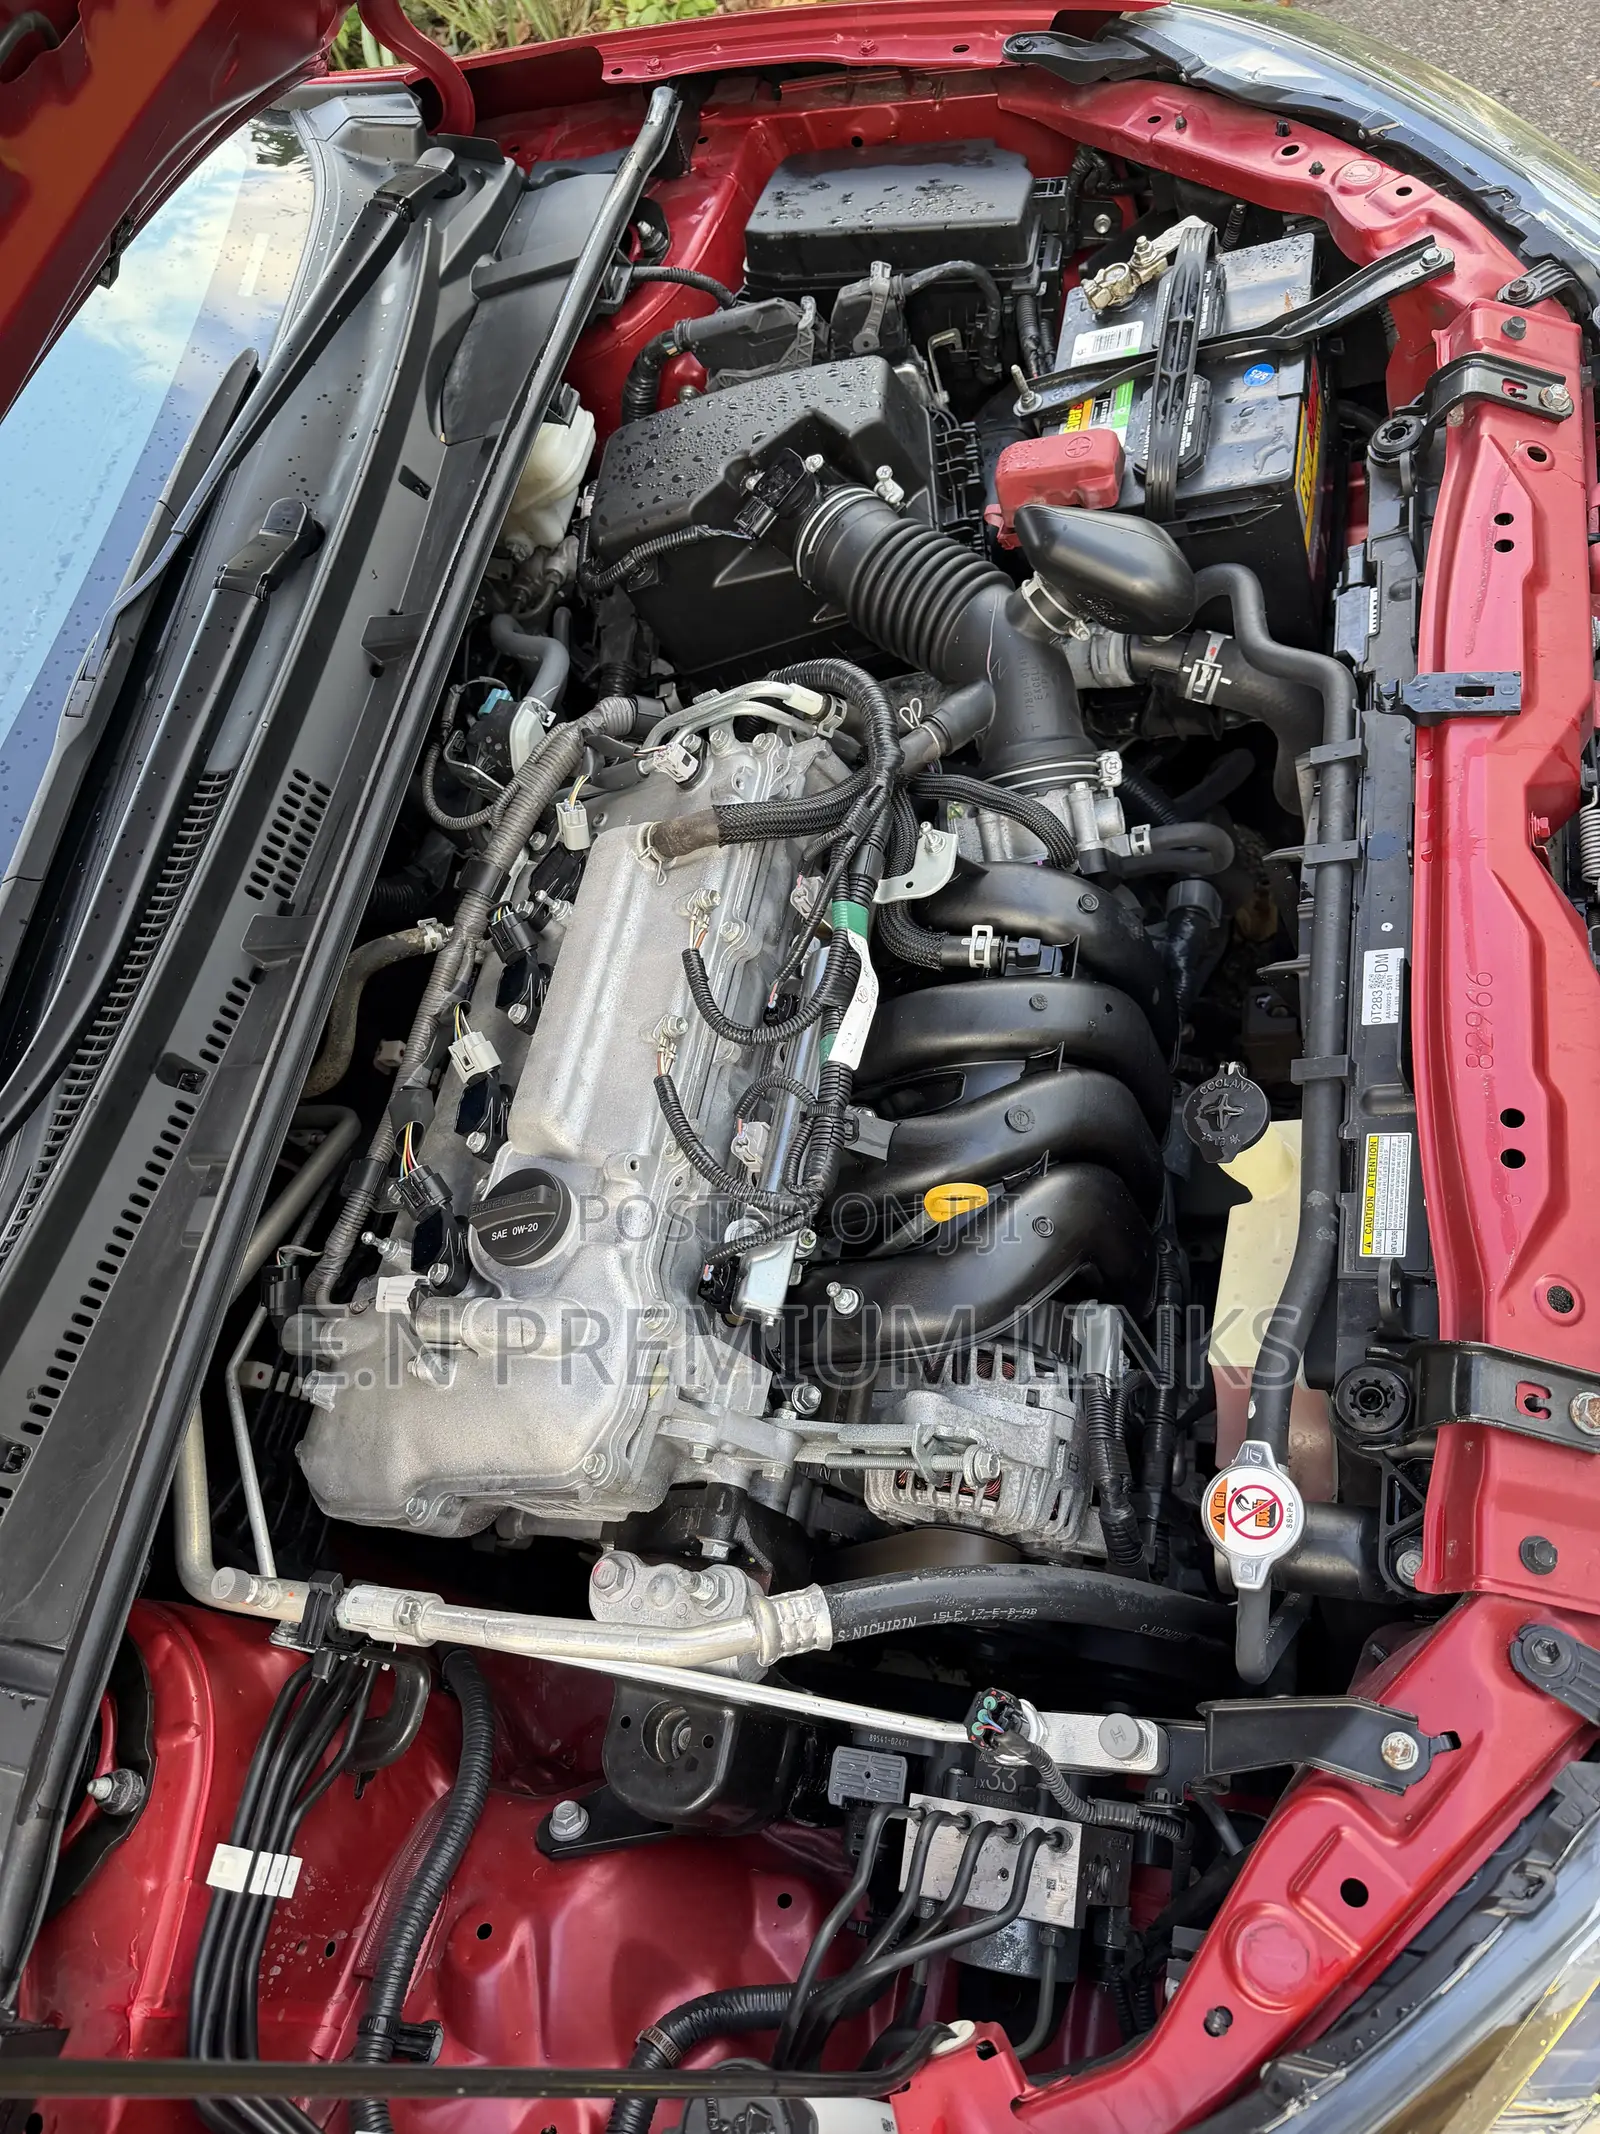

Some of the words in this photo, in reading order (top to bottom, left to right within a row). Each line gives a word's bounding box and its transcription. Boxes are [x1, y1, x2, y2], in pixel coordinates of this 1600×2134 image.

[1375, 954, 1388, 972] DM
[1200, 1078, 1253, 1095] COOLANT
[1368, 1142, 1377, 1188] ATTENTION
[1365, 1196, 1373, 1234] CAUTION
[492, 1229, 508, 1240] SAE
[512, 1223, 538, 1236] 0W-20
